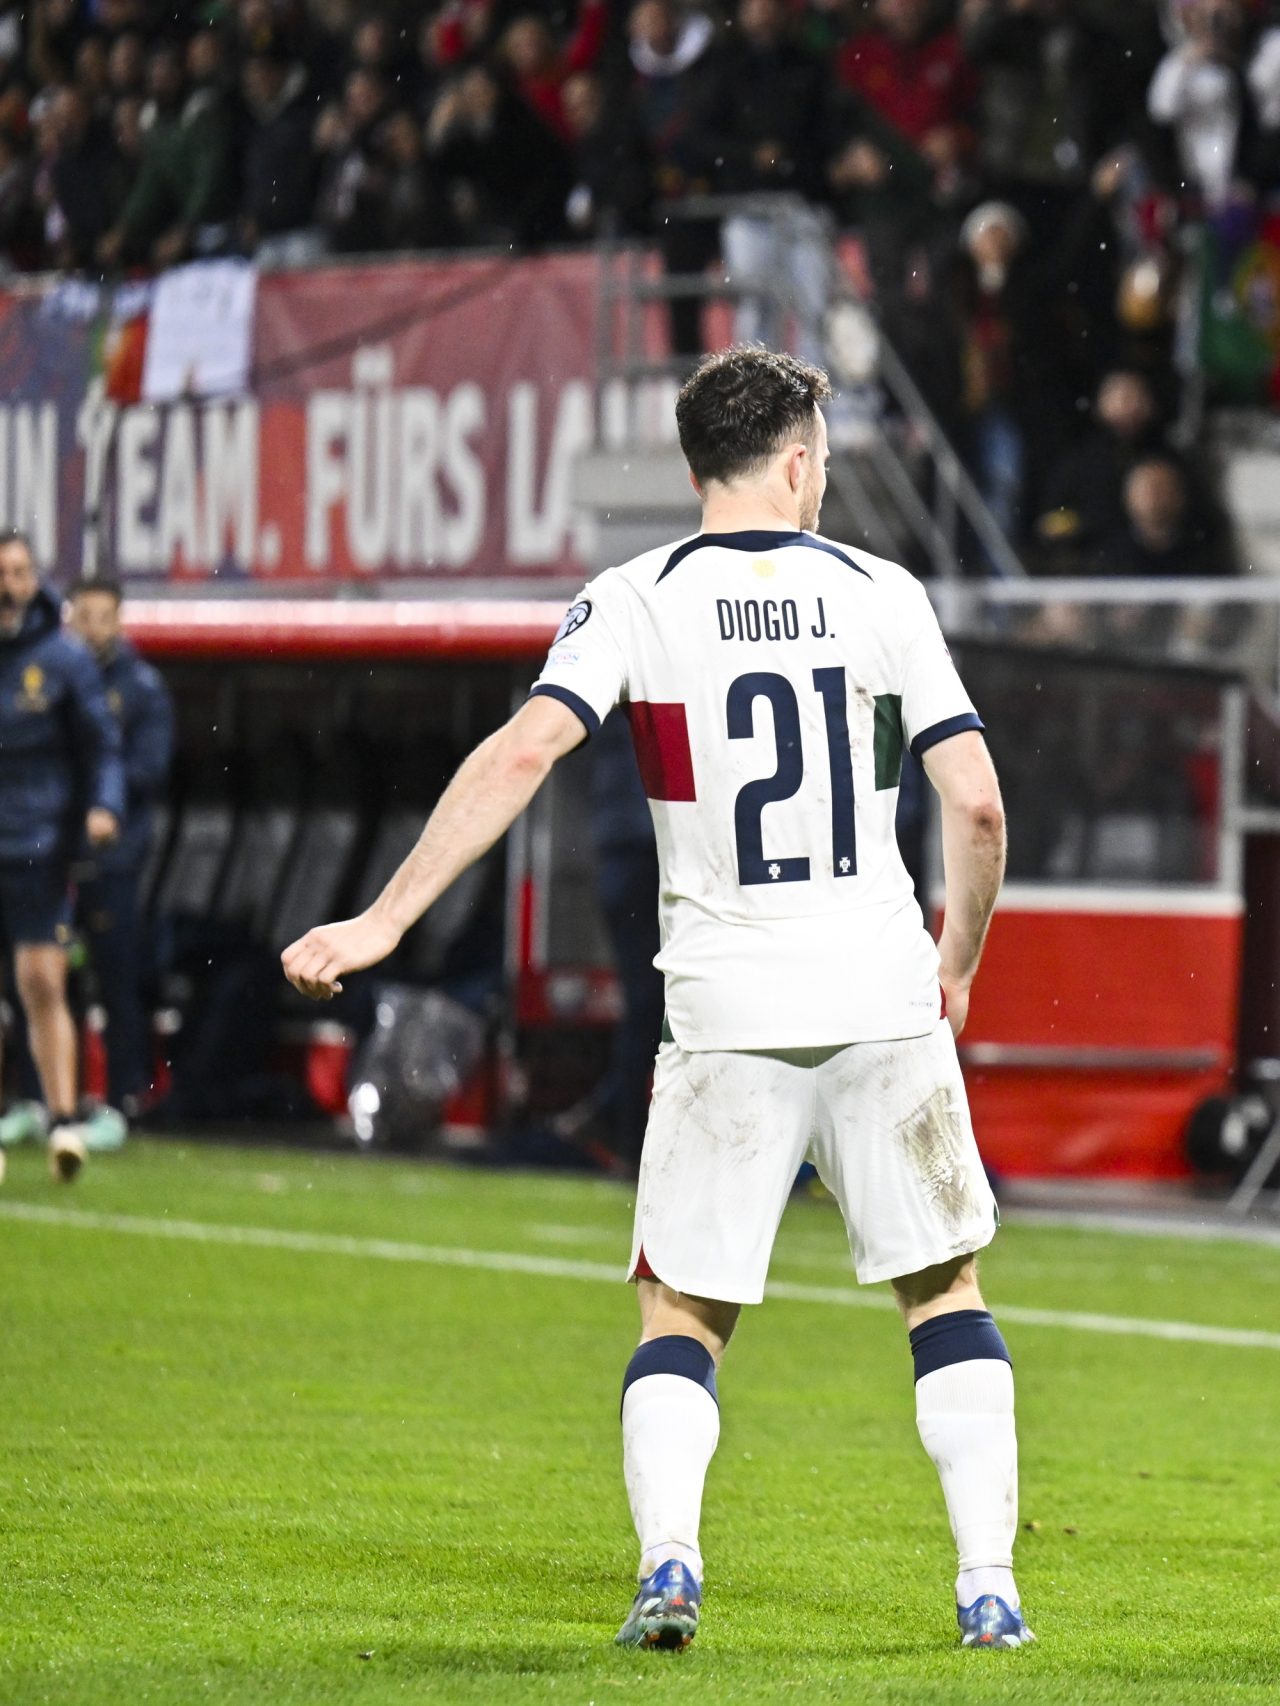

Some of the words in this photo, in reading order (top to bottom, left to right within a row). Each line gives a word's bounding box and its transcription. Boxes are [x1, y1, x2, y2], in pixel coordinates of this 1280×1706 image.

[75, 392, 282, 572] TEAM.
[305, 346, 487, 571] FÜRS
[716, 598, 800, 642] DIOGO
[811, 597, 836, 640] J.
[726, 666, 858, 886] 21
